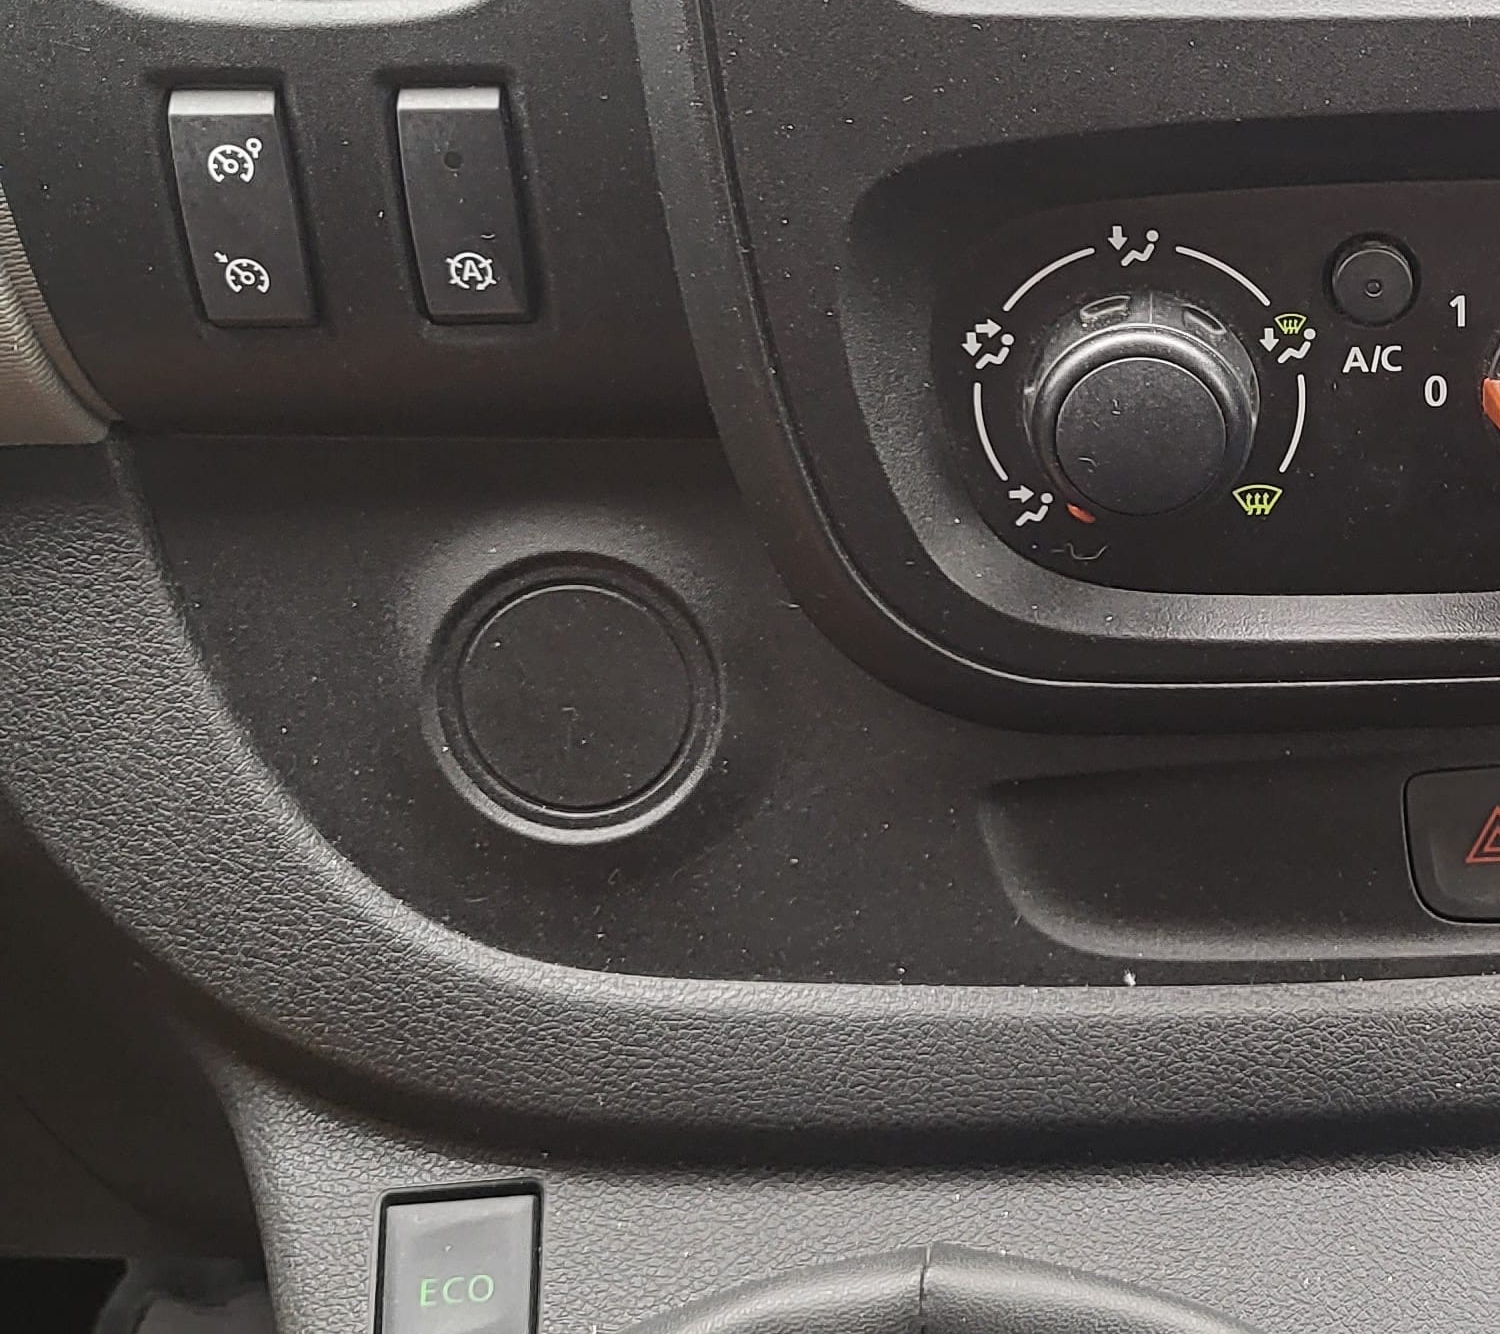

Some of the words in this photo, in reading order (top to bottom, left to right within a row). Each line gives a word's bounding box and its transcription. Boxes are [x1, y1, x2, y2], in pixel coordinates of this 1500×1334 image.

[1449, 294, 1468, 327] 1
[1342, 344, 1403, 374] A/C
[1423, 375, 1448, 407] 0
[418, 1274, 496, 1308] ECO
